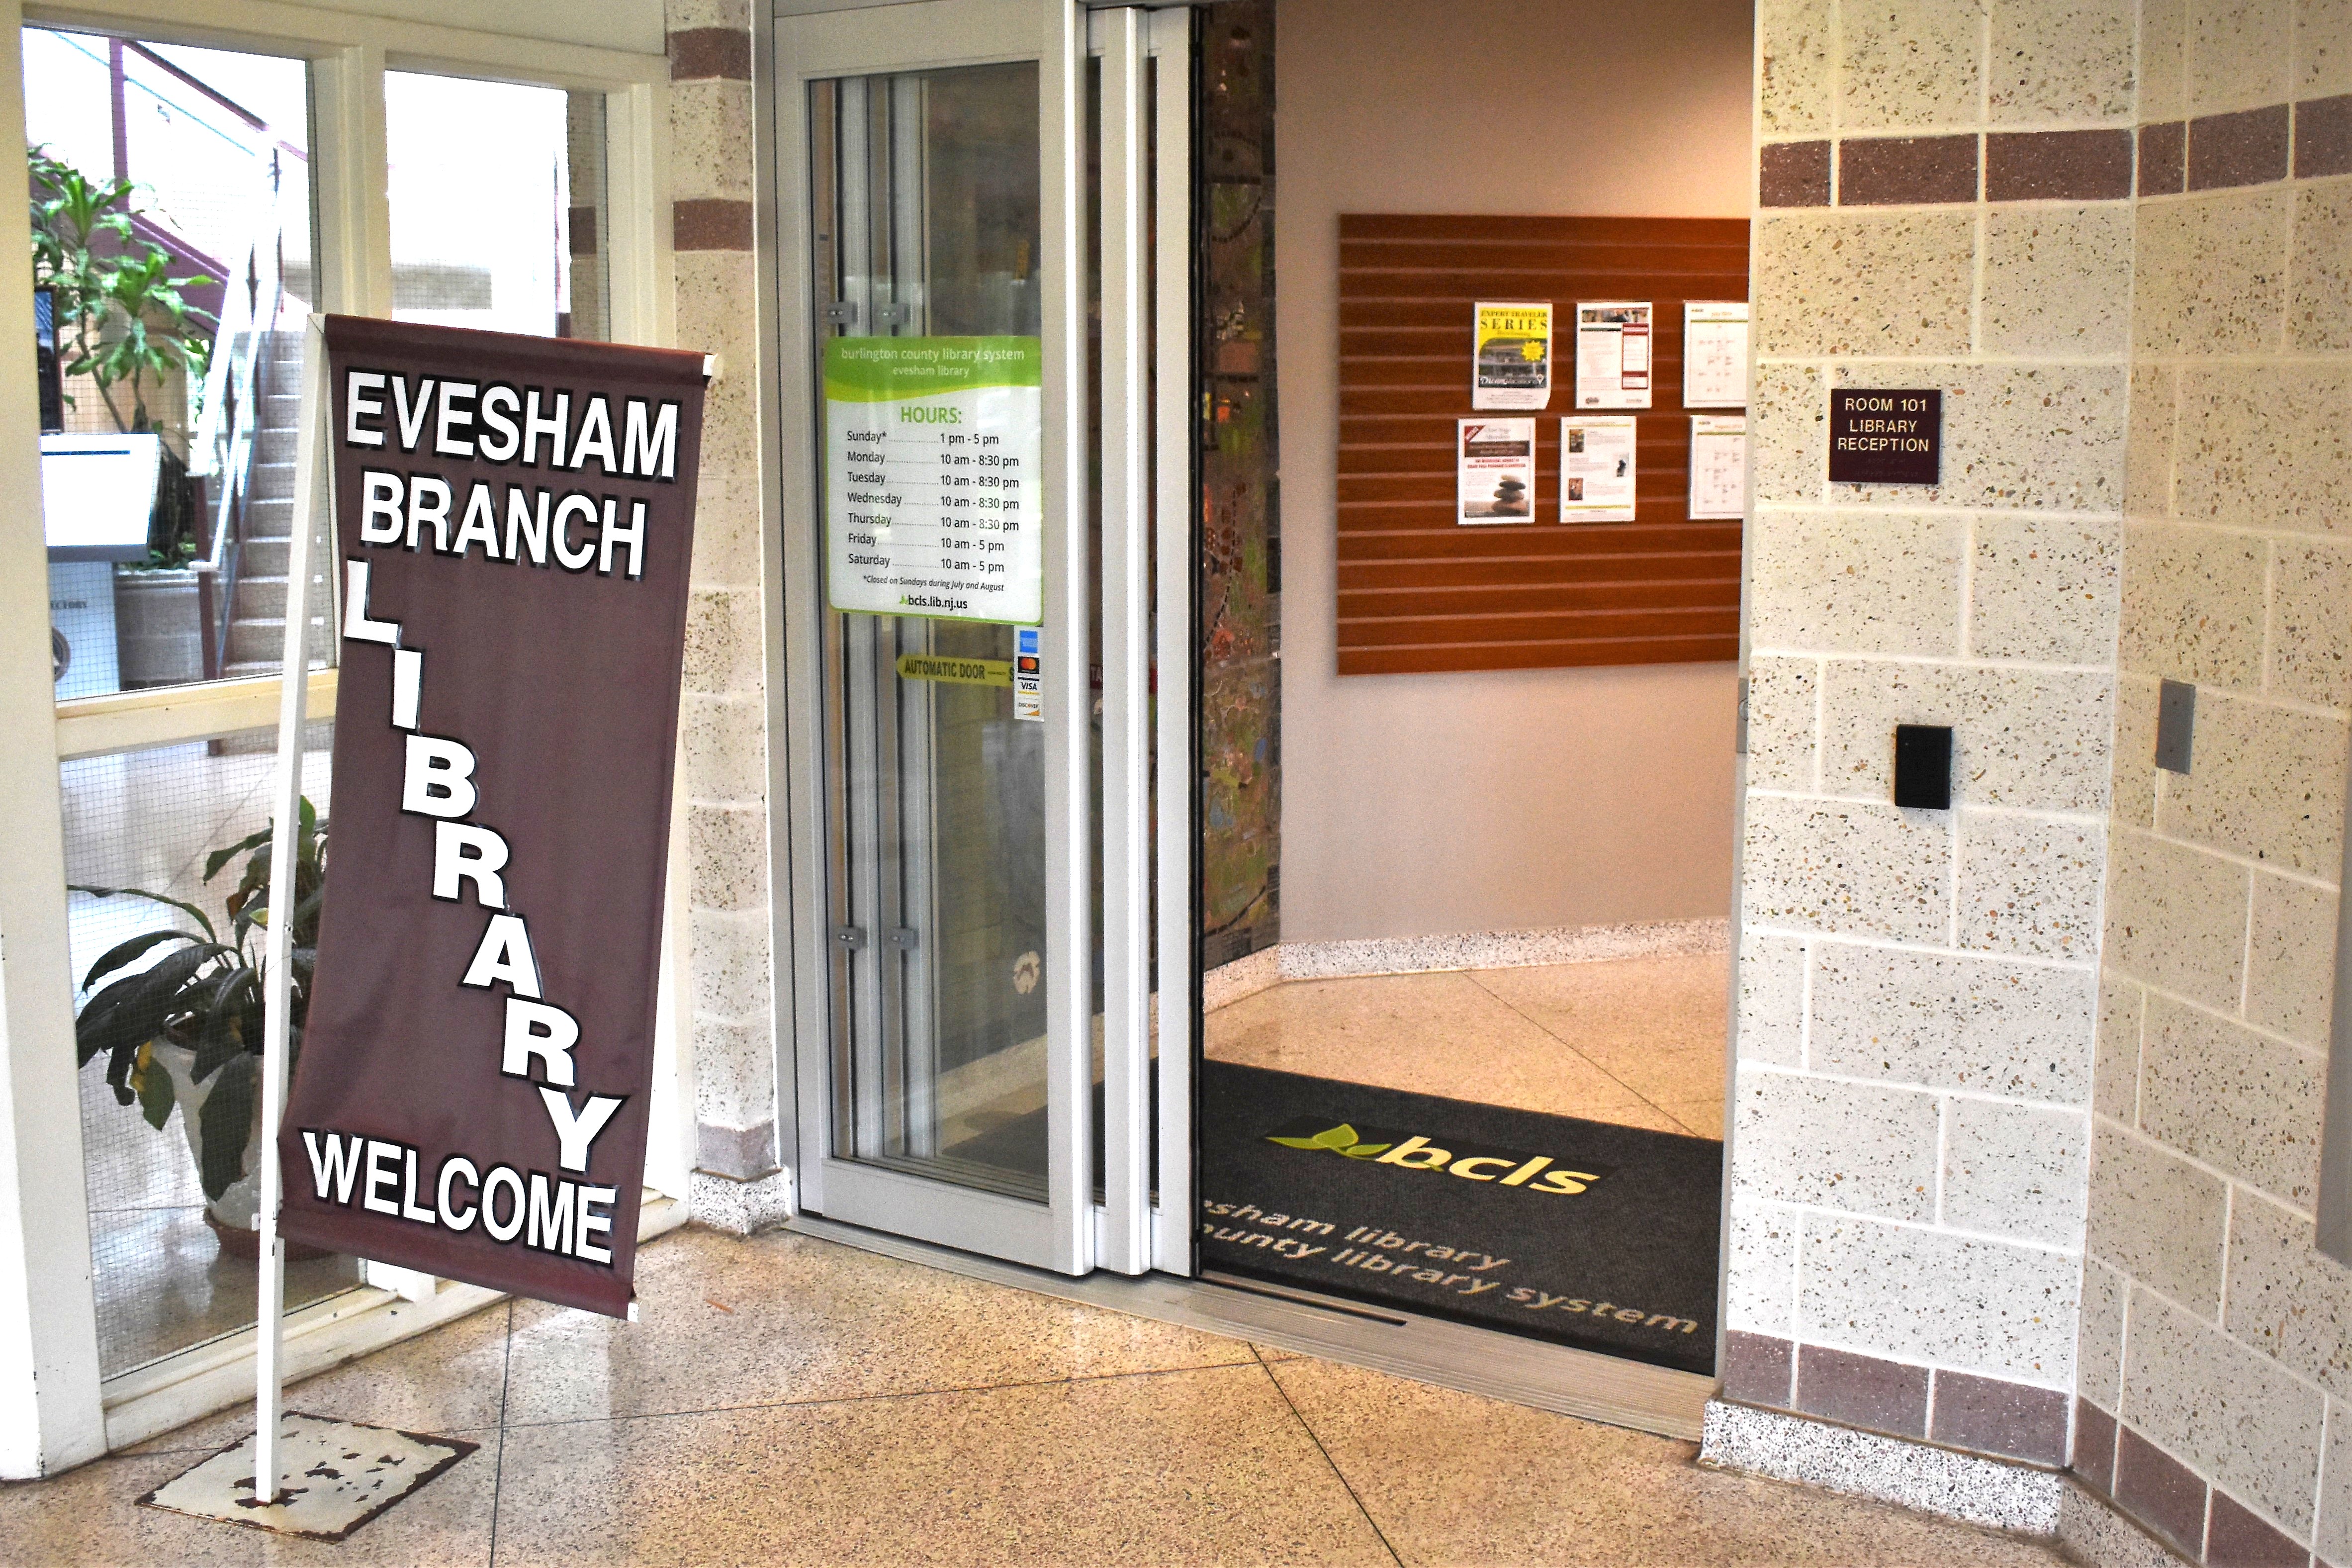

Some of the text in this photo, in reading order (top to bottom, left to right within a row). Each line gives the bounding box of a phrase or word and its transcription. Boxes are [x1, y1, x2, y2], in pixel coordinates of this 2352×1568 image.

[1480, 318, 1547, 329] SERIES
[841, 348, 1024, 363] burlington county library system
[893, 366, 970, 378] evesham library
[1845, 398, 1926, 411] ROOM 101
[346, 370, 678, 477] EVESHAM
[901, 407, 962, 424] HOURS:
[1850, 419, 1917, 433] LIBRARY
[940, 434, 945, 443] 1
[949, 435, 965, 445] pm
[974, 434, 980, 444] 5
[983, 436, 999, 446] pm
[1838, 437, 1928, 452] RECEPTION
[847, 452, 885, 465] Monday
[940, 455, 951, 464] 10
[954, 457, 970, 465] am
[979, 456, 999, 466] 8:30
[1003, 457, 1019, 468] pm
[847, 472, 886, 485] Tuesday
[940, 475, 951, 486] 10
[954, 478, 970, 486] am
[979, 476, 999, 487] 8:30
[1003, 478, 1019, 489] pm
[847, 493, 902, 506] Wednesday
[940, 496, 951, 507] 10
[954, 499, 970, 507] am
[979, 497, 999, 508] 8:30
[1003, 499, 1019, 510] pm
[361, 471, 646, 576] BRANCH
[848, 513, 892, 526] Thursday
[940, 517, 951, 527] 10
[954, 519, 970, 528] am
[979, 518, 999, 529] 8:30
[1003, 520, 1019, 531] pm
[848, 533, 877, 547] Friday
[940, 538, 951, 548] 10
[954, 540, 970, 549] am
[979, 539, 984, 549] 5
[988, 540, 1004, 552] pm
[848, 554, 890, 567] Saturday
[940, 559, 951, 569] 10
[954, 561, 970, 570] am
[979, 560, 984, 570] 5
[988, 561, 1004, 572] pm
[900, 577, 927, 586] Sundays
[929, 580, 950, 589] during
[951, 581, 964, 590] July
[981, 582, 1004, 592] August
[908, 595, 968, 610] bcls.lib.nj.us
[905, 659, 985, 679] AUTOMATIC DOOR
[1021, 682, 1037, 690] VISA
[344, 559, 623, 1175] LIBRARY
[1374, 1135, 1601, 1195] bcls
[302, 1131, 617, 1264] WELCOME
[1345, 1226, 1510, 1272] library
[1331, 1246, 1502, 1294] library
[1506, 1286, 1698, 1334] system
